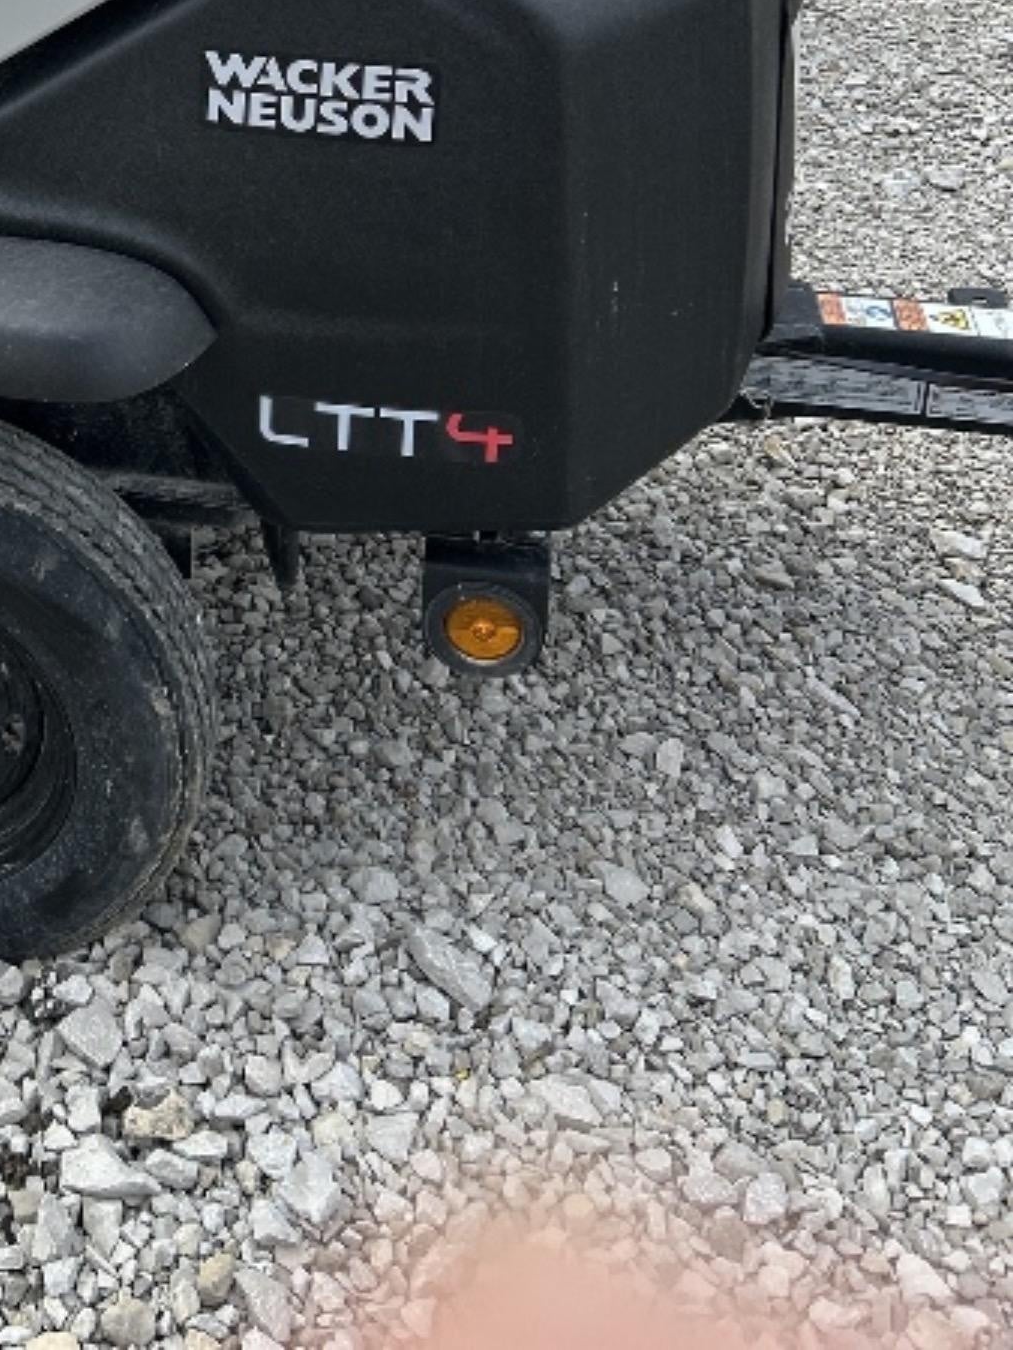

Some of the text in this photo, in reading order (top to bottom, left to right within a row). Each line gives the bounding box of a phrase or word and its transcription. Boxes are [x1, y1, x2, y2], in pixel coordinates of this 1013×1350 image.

[204, 50, 436, 106] WACKER
[206, 86, 435, 143] NEUSON
[258, 394, 514, 464] LTT4
